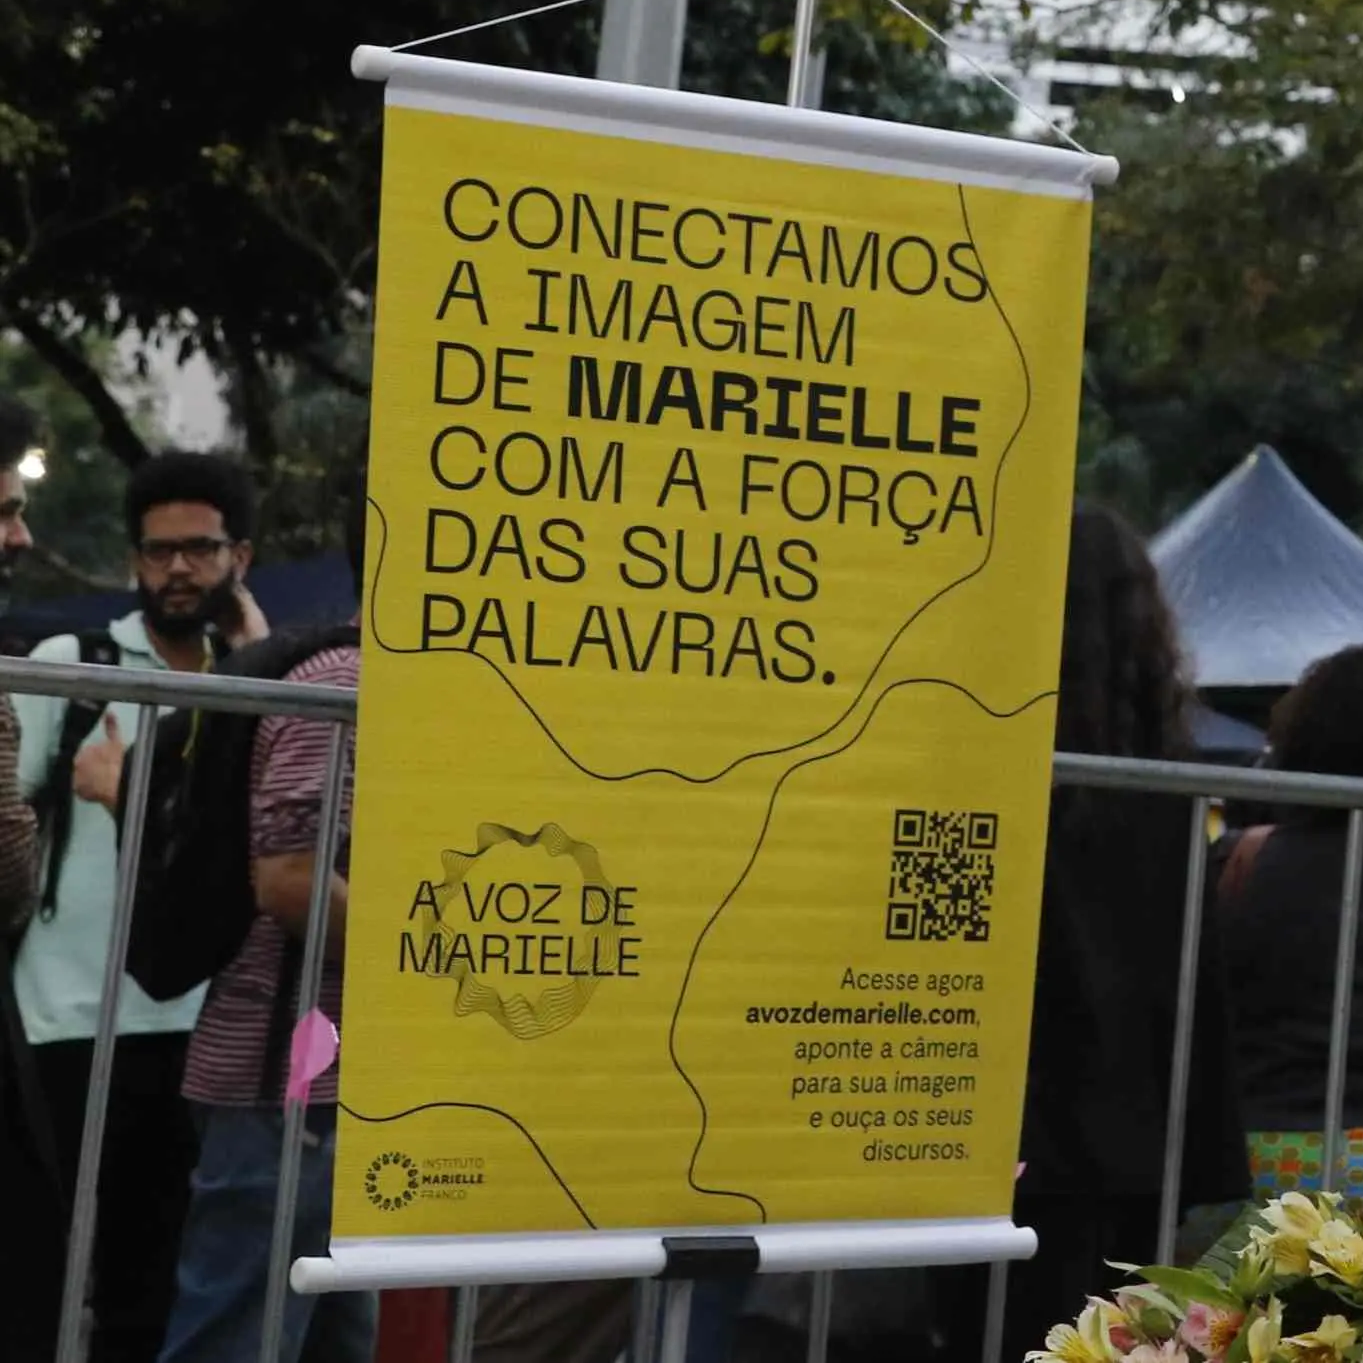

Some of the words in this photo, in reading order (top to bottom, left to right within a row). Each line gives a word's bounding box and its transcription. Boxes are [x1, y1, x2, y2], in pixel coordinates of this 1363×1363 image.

[444, 178, 987, 302] CONECTAMOS
[436, 260, 488, 326] A
[525, 268, 855, 366] IMAGEM
[434, 341, 534, 412] DE
[567, 355, 981, 457] MARIELLE
[430, 425, 623, 504] COM
[657, 448, 706, 511] A
[741, 454, 983, 545] FORÇA
[425, 508, 586, 583] DAS
[619, 525, 819, 602] SUAS
[421, 593, 835, 686] PALAVRAS.
[408, 881, 441, 921] A
[463, 882, 562, 924] VOZ
[581, 885, 637, 926] DE
[398, 932, 642, 976] MARIELLE
[841, 967, 919, 991] Acesse
[926, 973, 984, 997] agora
[746, 1001, 981, 1028] avozdemarielle.com,
[794, 1039, 873, 1065] aponte
[880, 1041, 893, 1059] a
[900, 1036, 979, 1059] câmera
[791, 1075, 842, 1100] para
[850, 1075, 887, 1094] sua
[894, 1070, 976, 1098] imagem
[809, 1110, 823, 1128] e
[831, 1109, 886, 1133] ouça
[894, 1109, 919, 1126] os
[926, 1108, 973, 1126] seus
[863, 1139, 969, 1162] discursos.
[421, 1173, 484, 1185] MARIELLE
